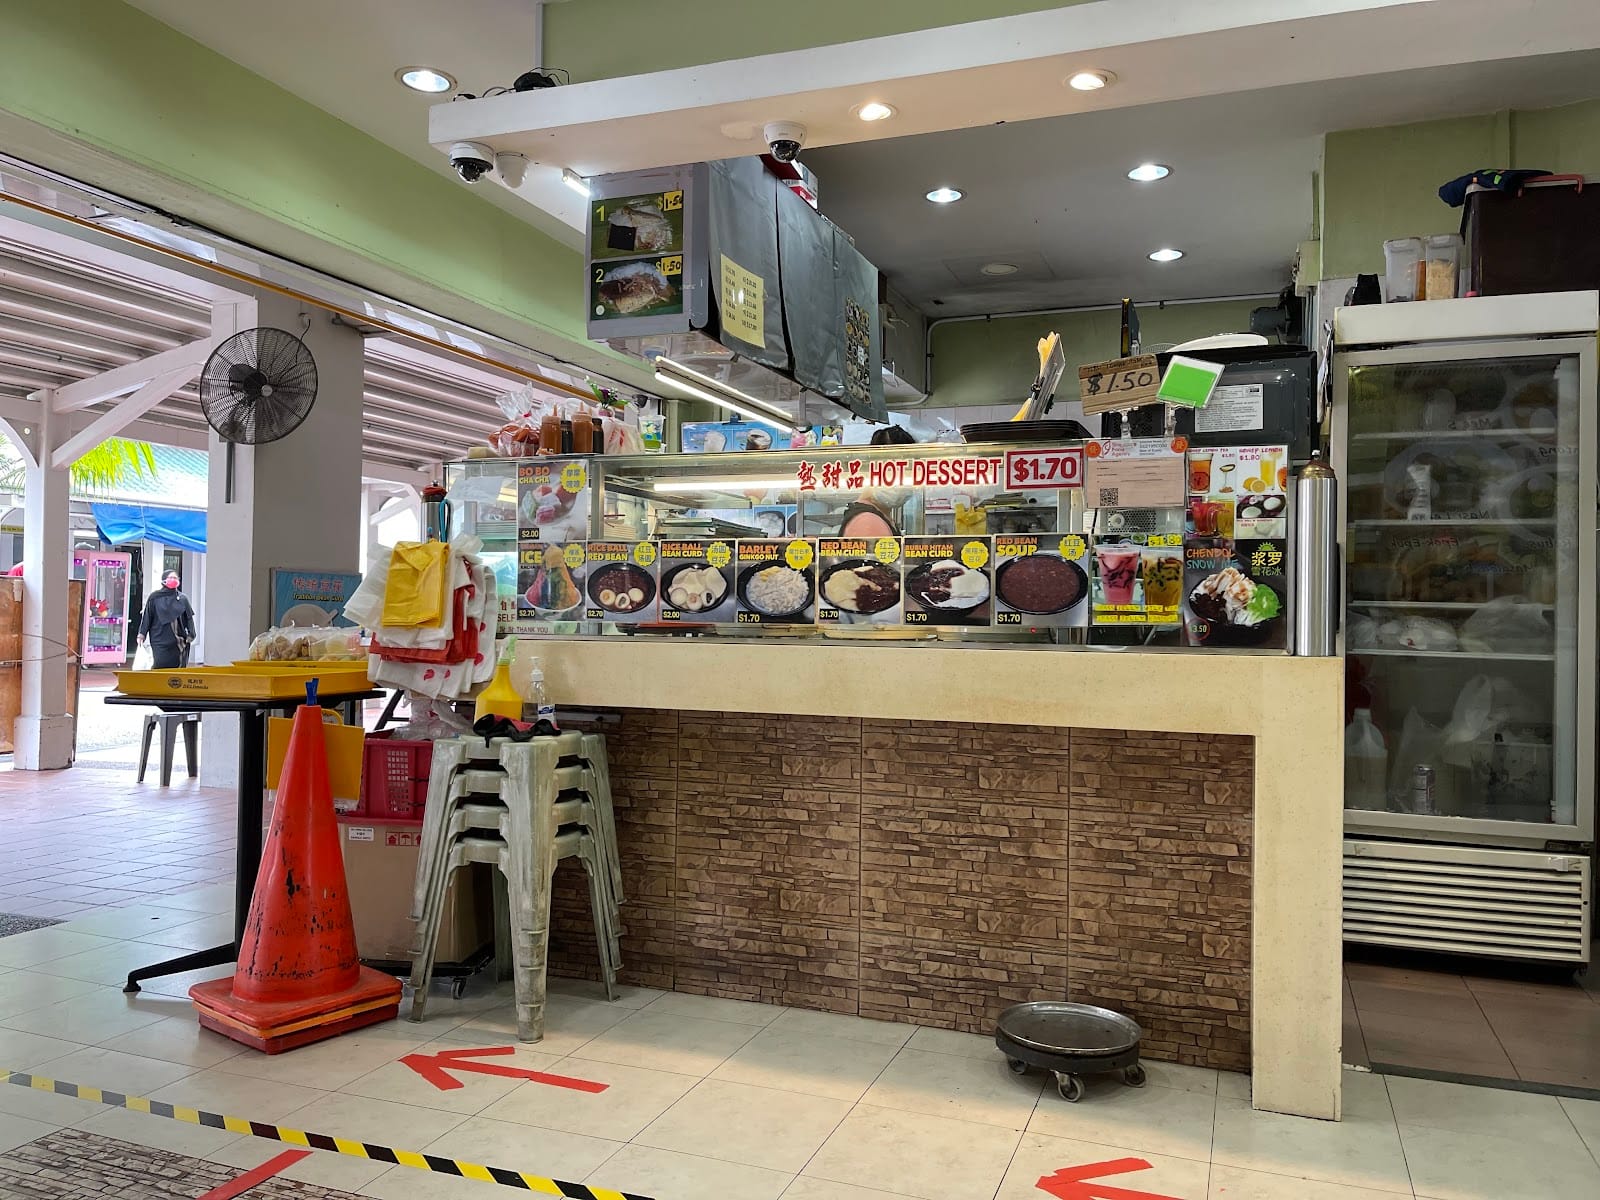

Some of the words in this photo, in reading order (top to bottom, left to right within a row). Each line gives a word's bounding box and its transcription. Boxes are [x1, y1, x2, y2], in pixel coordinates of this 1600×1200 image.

[596, 206, 605, 222] 1
[595, 268, 604, 283] 2
[1088, 372, 1152, 395] $1.50
[519, 467, 534, 477] BO
[535, 466, 550, 476] BO
[870, 461, 908, 487] HOT
[913, 458, 1002, 486] DESSERT
[1013, 456, 1078, 482] $1.70
[535, 476, 550, 484] CHA
[521, 530, 539, 538] $2.00
[820, 541, 839, 549] RED
[841, 541, 867, 549] BEAN
[996, 537, 1013, 545] RED
[588, 543, 607, 552] RICE
[608, 543, 628, 552] BALL
[662, 543, 681, 551] RICE
[682, 543, 703, 551] BALL
[738, 545, 778, 554] BARLEY
[996, 544, 1038, 556] SOUP
[520, 550, 542, 564] ICE
[588, 553, 604, 561] RED
[605, 553, 628, 561] BEAN
[820, 549, 843, 557] BEAN
[905, 550, 928, 558] BEAN
[1186, 548, 1237, 558] CHENDOL
[1186, 559, 1216, 569] SNOW
[497, 613, 516, 622] SELF
[738, 613, 760, 622] $1.70
[820, 610, 839, 618] $1.70
[906, 613, 928, 622] $1.70
[998, 614, 1021, 622] $1.70
